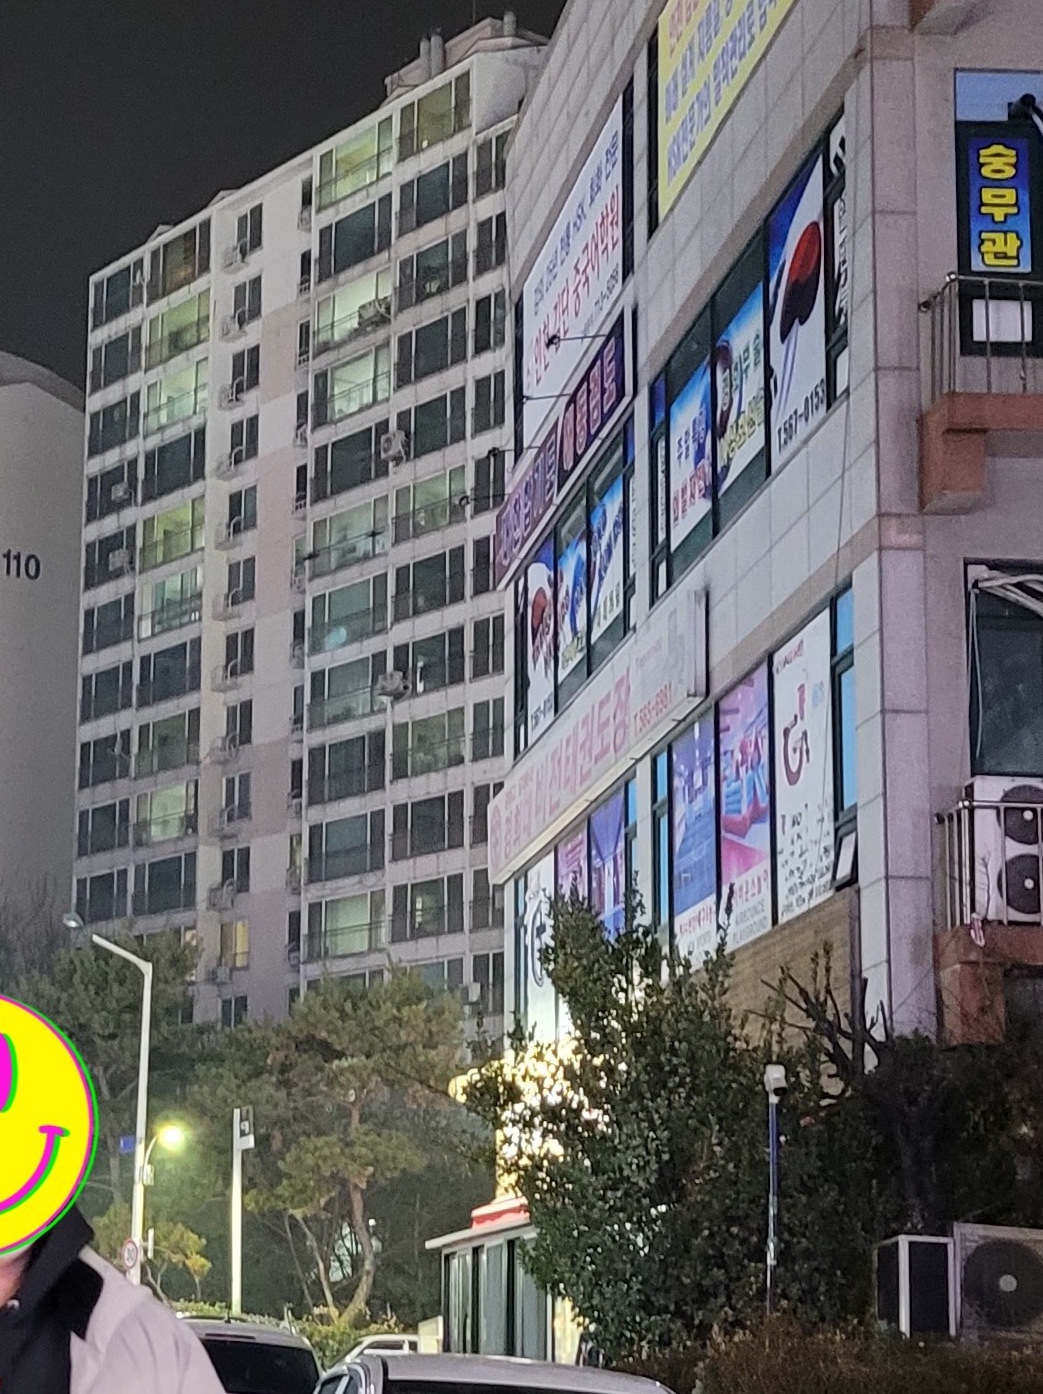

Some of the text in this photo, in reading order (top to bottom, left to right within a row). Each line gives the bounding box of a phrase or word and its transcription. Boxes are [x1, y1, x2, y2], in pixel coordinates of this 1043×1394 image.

[572, 184, 620, 320] 중국어학원
[776, 377, 826, 458] T.567-0153
[2, 549, 41, 581] 110
